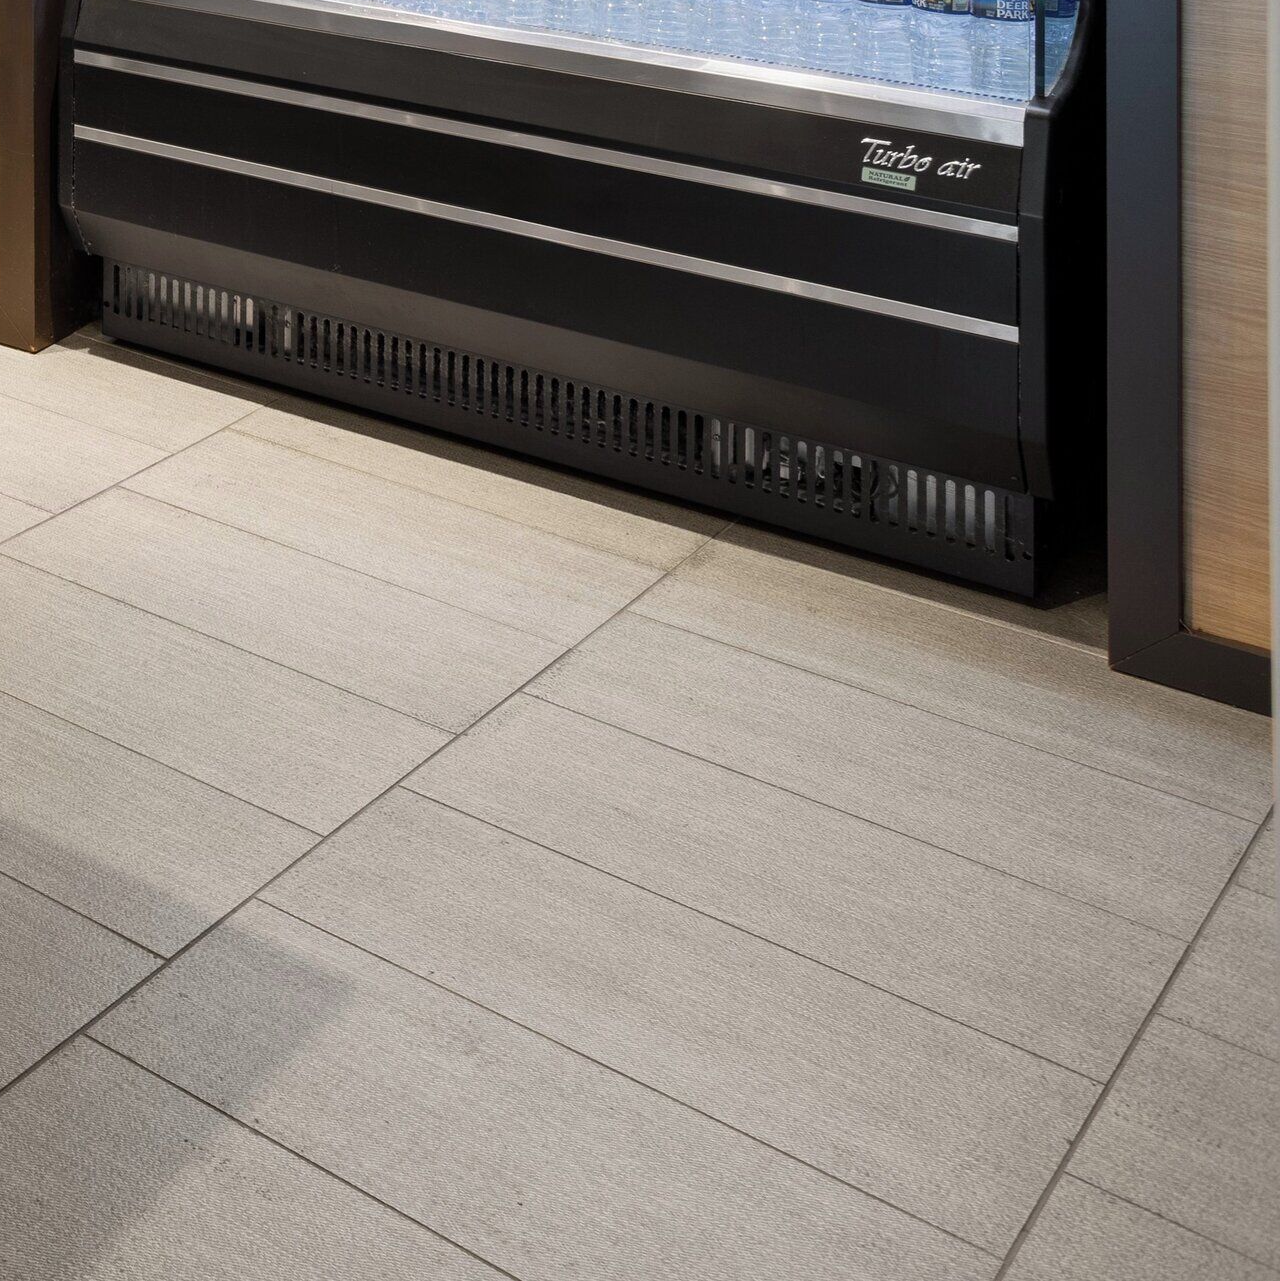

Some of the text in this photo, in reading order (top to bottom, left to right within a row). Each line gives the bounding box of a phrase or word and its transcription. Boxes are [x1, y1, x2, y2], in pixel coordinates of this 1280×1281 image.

[996, 8, 1029, 20] PARK
[860, 137, 982, 180] Turbo air
[868, 170, 904, 182] NATURAL
[868, 175, 908, 188] Refrigerant
